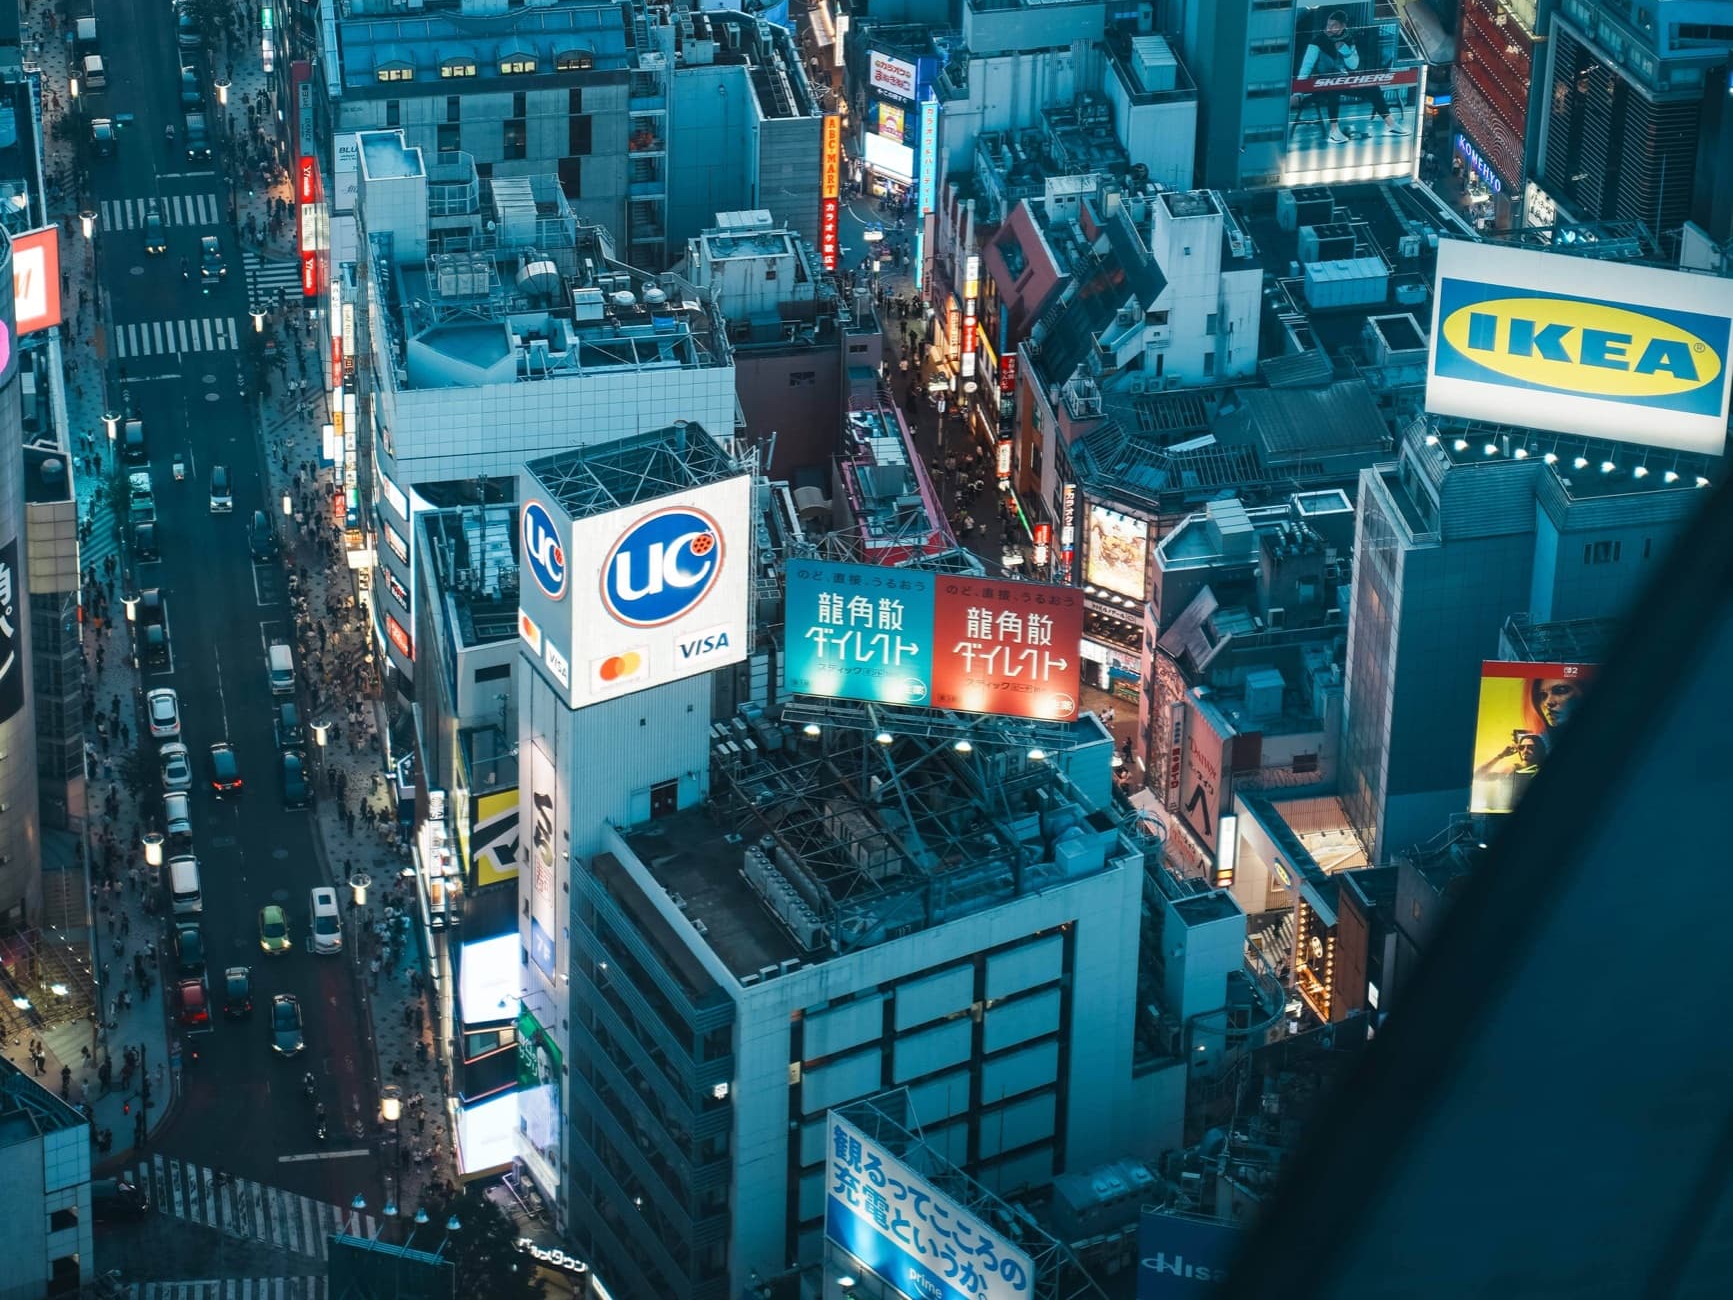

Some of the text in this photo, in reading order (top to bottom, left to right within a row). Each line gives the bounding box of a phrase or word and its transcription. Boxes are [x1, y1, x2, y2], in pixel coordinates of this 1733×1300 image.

[1313, 72, 1396, 88] SKECHERS
[1459, 134, 1501, 192] KOMEHYO
[1468, 312, 1701, 382] IKEA
[526, 512, 563, 582] UC
[615, 531, 711, 601] UC
[818, 592, 905, 631] 龍角散
[966, 606, 1054, 646] 龍角散
[679, 632, 729, 659] VISA
[804, 626, 920, 666] ダイレクト
[952, 641, 1068, 682] ダイレクト
[549, 654, 568, 679] VISA
[833, 1124, 1027, 1291] 観るってこころの
[833, 1162, 988, 1300] 充電というか。
[908, 1267, 943, 1299] prime
